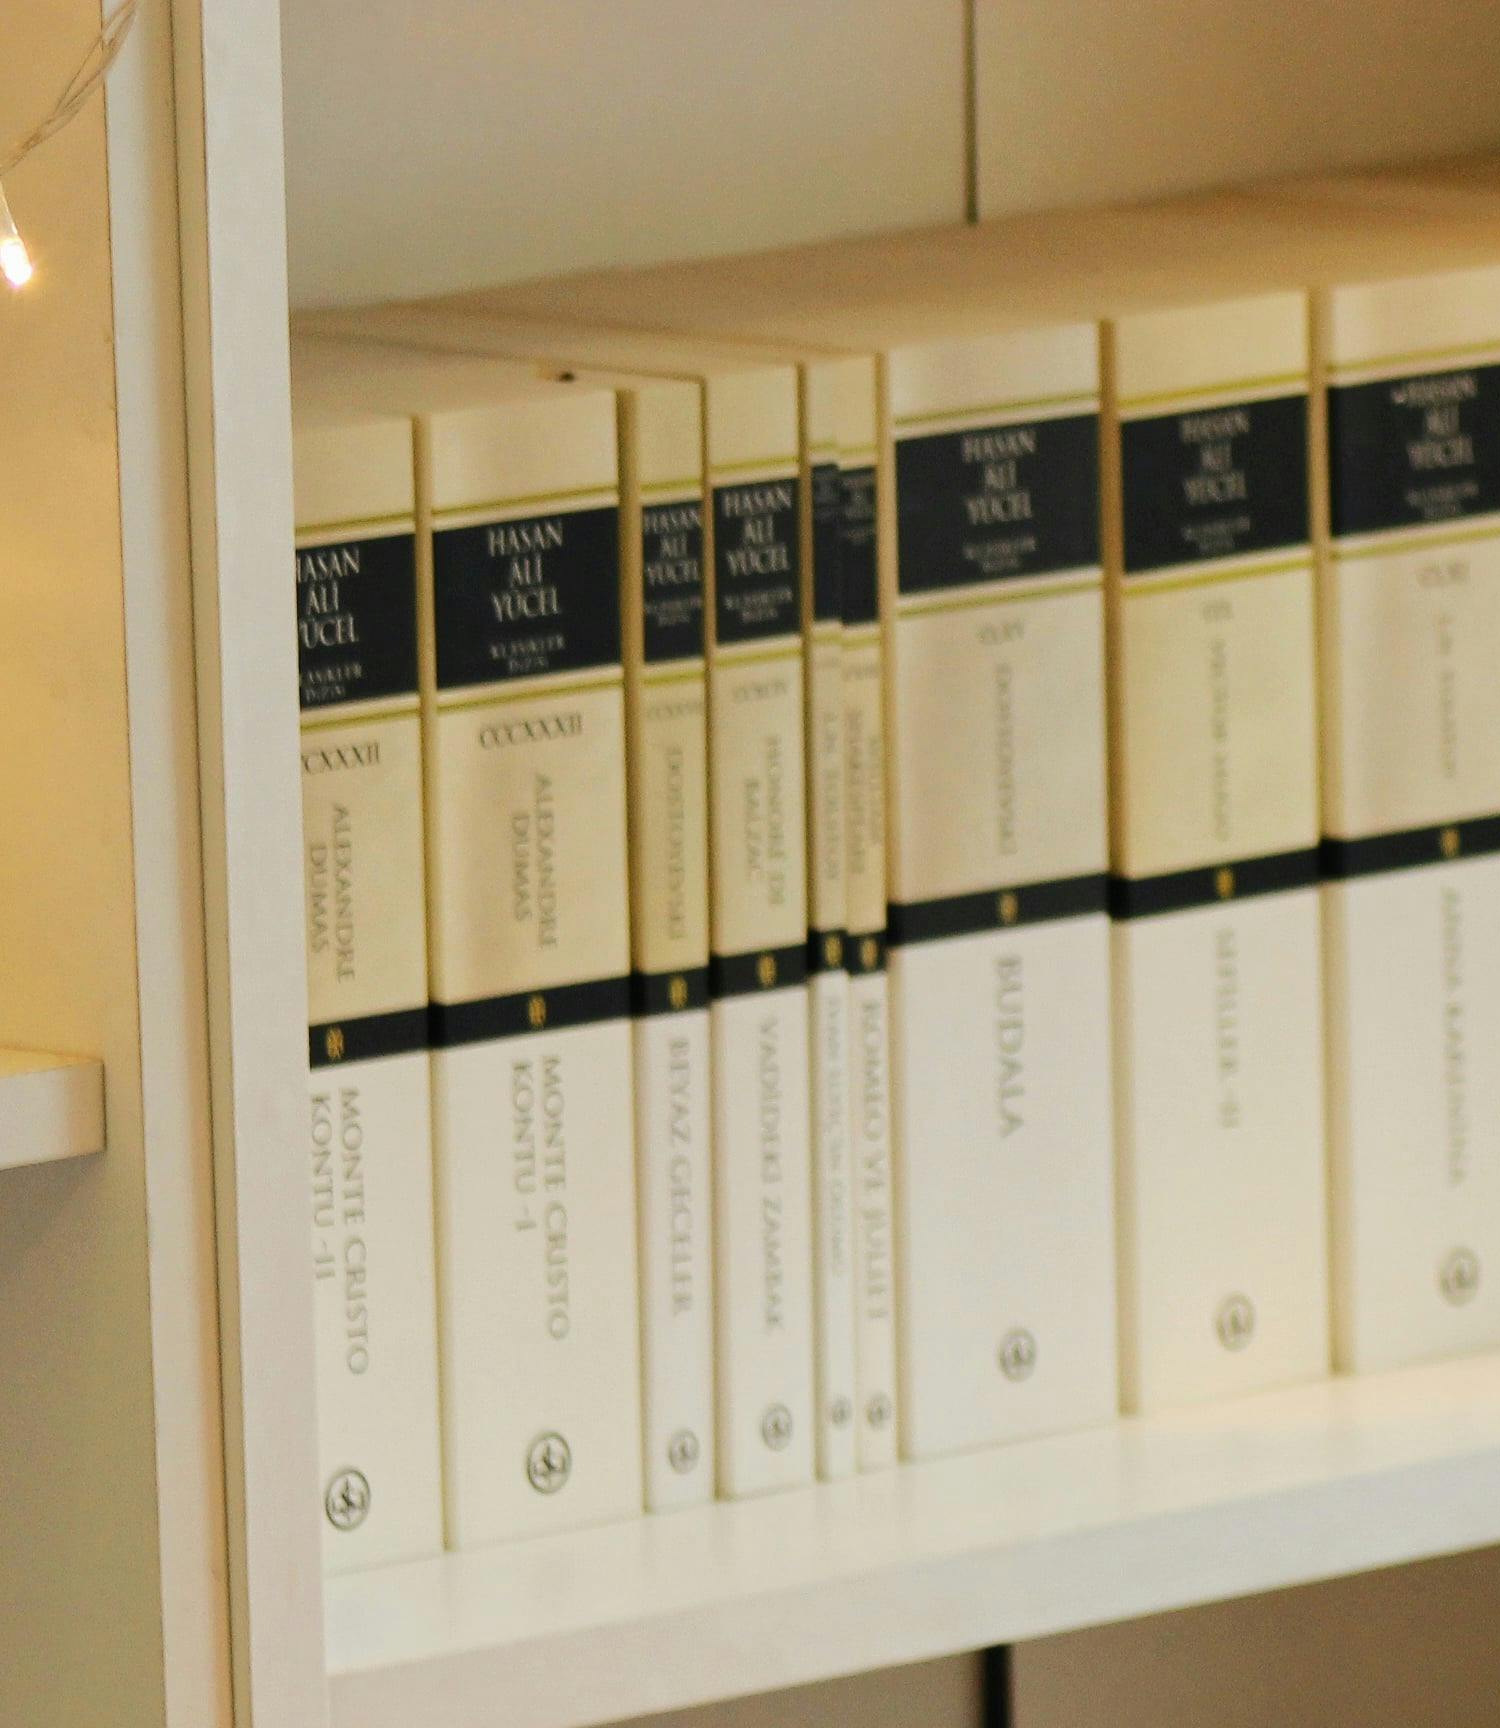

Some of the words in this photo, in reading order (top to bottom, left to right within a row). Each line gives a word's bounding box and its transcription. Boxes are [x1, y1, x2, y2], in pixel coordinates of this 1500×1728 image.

[490, 523, 563, 556] HASAN
[725, 487, 791, 516] HASAN
[299, 613, 358, 648] ÜCEL
[309, 844, 329, 952] DUMAS
[333, 805, 355, 980] ALEXANDRE
[511, 815, 532, 922] DUMAS
[535, 773, 557, 949] ALEXANDRE
[669, 1036, 691, 1145] BEYAZ
[862, 1000, 885, 1141] ROMEO
[997, 957, 1025, 1139] BUDALA
[311, 1095, 333, 1227] KONTU
[341, 1087, 364, 1225] MONTE
[512, 1061, 535, 1193] KONTU
[542, 1054, 566, 1192] MONTE
[865, 1150, 886, 1192] VE
[344, 1235, 369, 1374] CRISTO
[546, 1202, 569, 1339] CRISTO
[670, 1156, 693, 1317] GECELER
[763, 1196, 784, 1332] ZAMBAK
